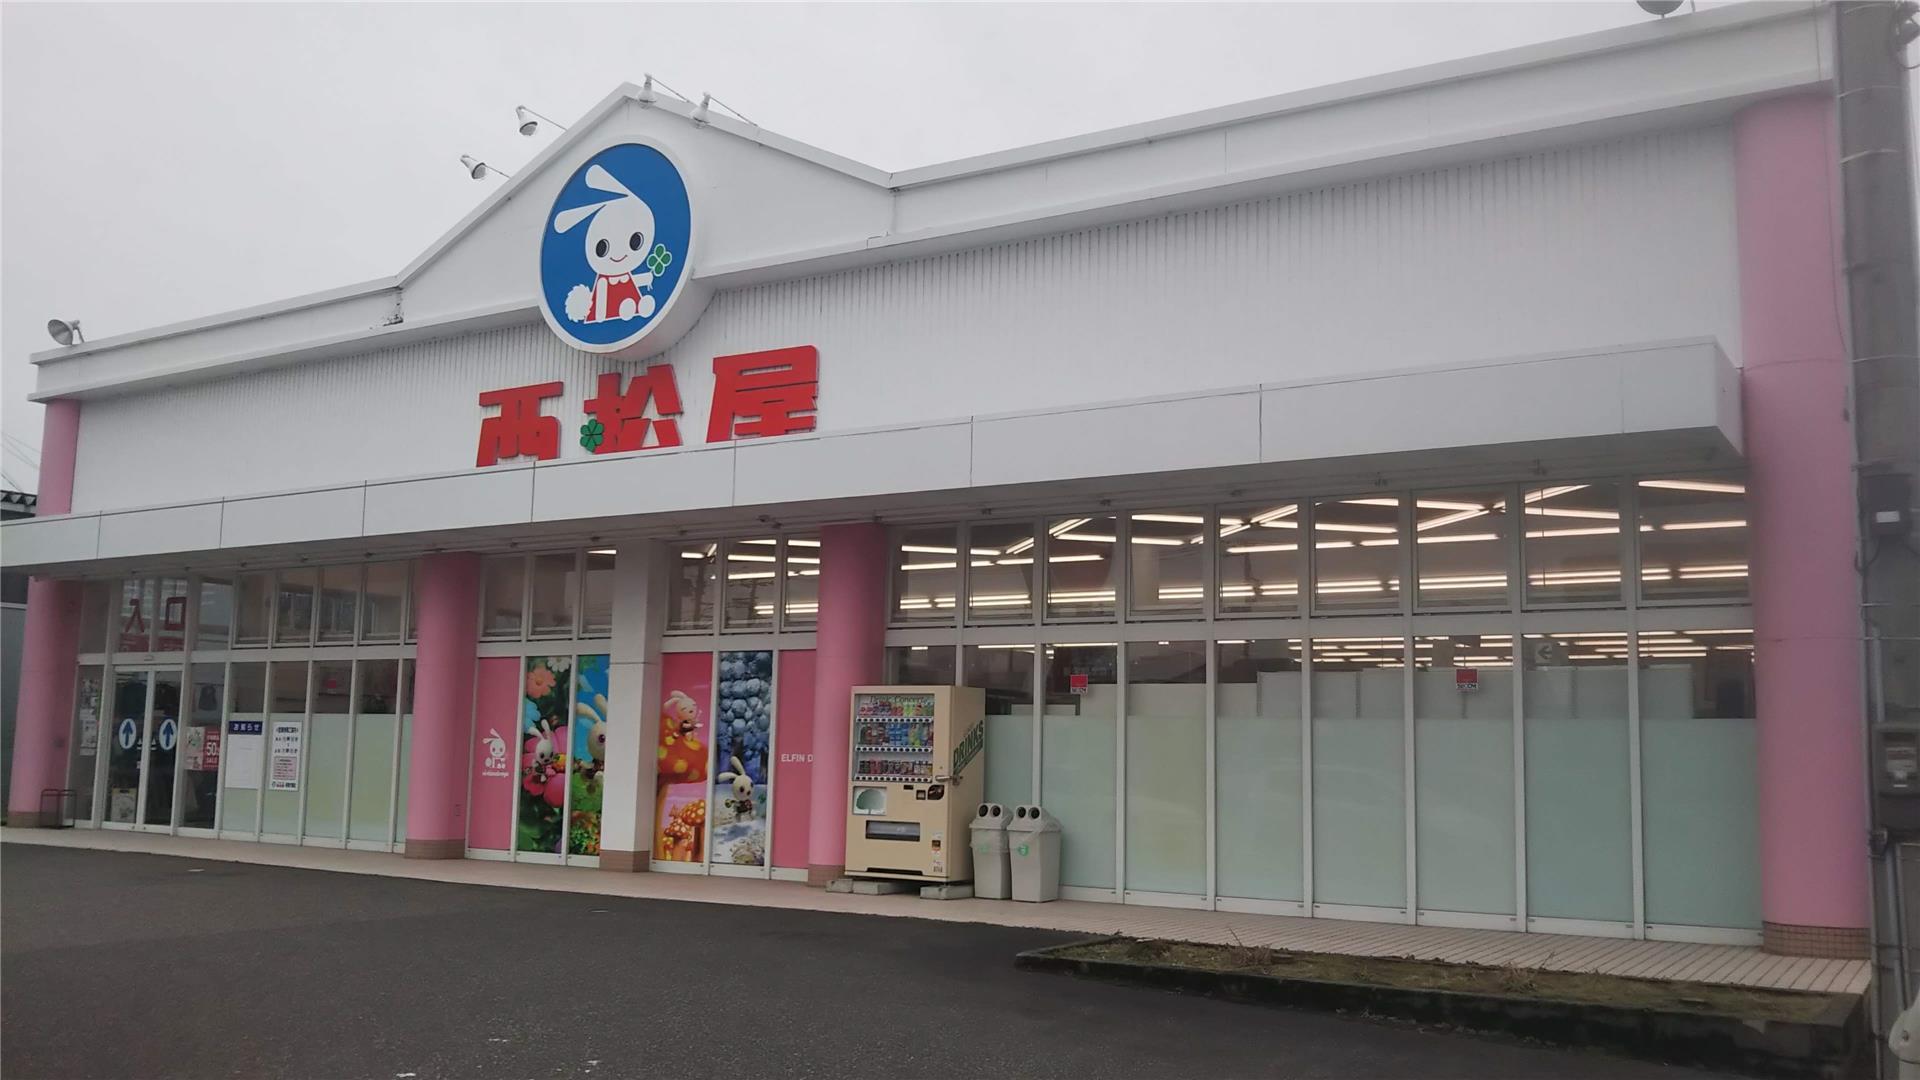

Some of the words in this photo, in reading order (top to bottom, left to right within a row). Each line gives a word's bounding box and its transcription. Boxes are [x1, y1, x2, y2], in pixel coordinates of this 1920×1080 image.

[476, 345, 819, 467] 西松屋
[125, 597, 187, 632] 入口
[233, 723, 260, 732] お知らせ
[953, 720, 983, 768] DRINKS
[781, 753, 805, 762] ELFIN
